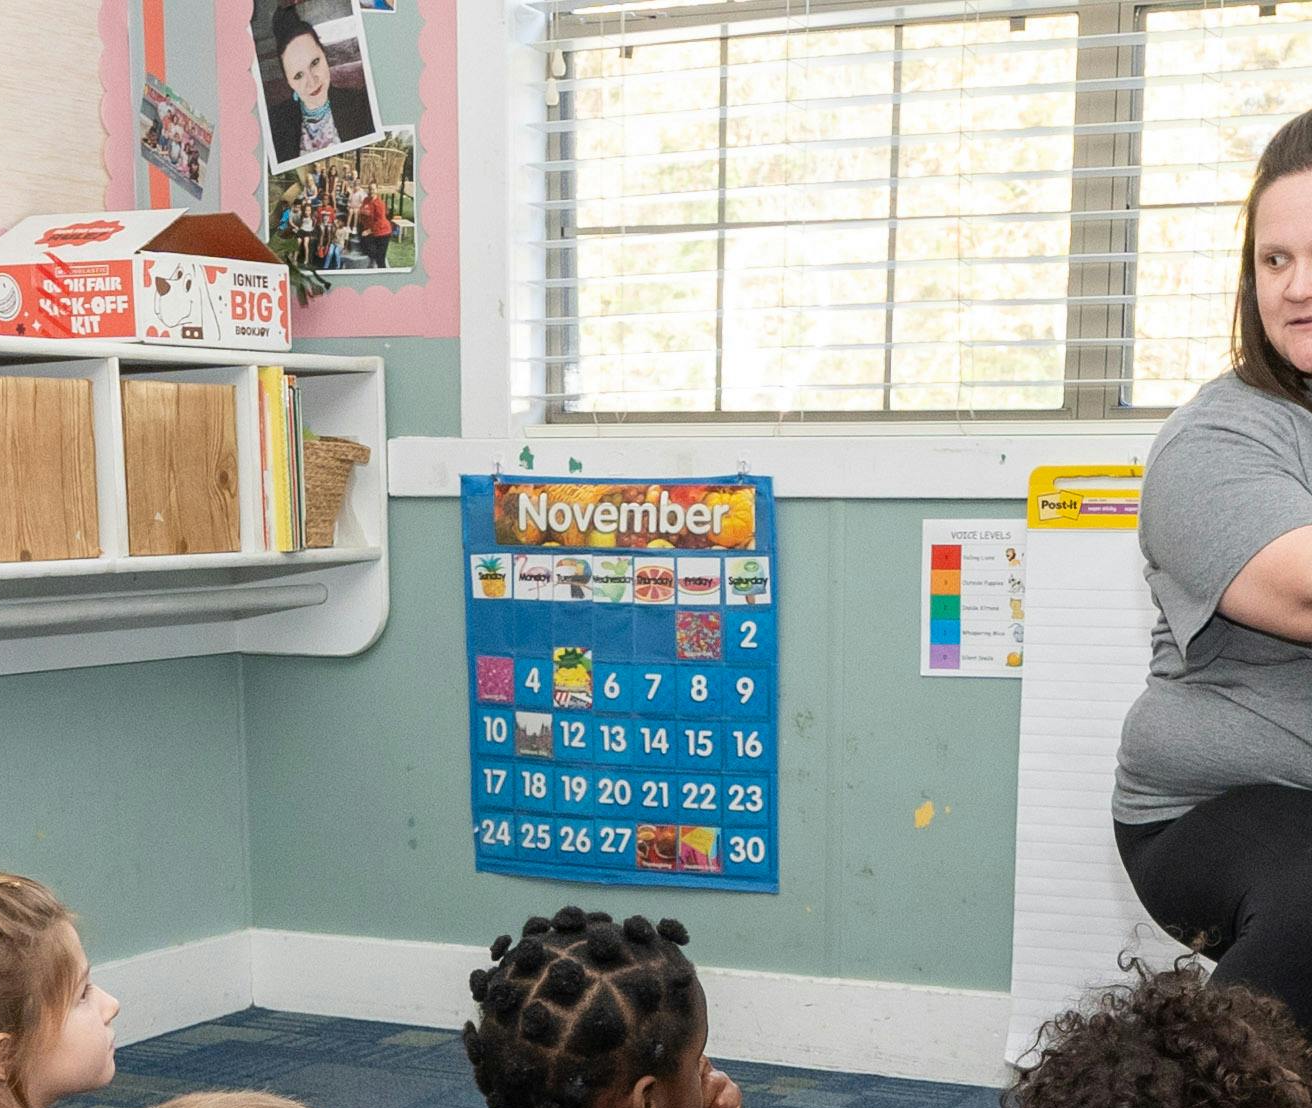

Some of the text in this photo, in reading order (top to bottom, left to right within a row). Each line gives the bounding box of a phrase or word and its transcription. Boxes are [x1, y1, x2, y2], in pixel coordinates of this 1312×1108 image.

[86, 276, 122, 291] FAIR
[233, 273, 269, 288] IGNITE
[230, 290, 273, 322] BIG
[70, 315, 101, 335] KIT
[517, 491, 729, 534] November
[1041, 500, 1078, 510] Post-it
[951, 531, 1012, 540] VOICE LEVELS
[478, 572, 507, 582] Sunday
[519, 573, 551, 583] Monday
[684, 577, 713, 587] Friday
[728, 576, 768, 589] Saturday
[740, 621, 758, 648] 2
[525, 668, 754, 704] 4 6 7 8 9
[483, 716, 763, 758] 10 12 13 14 15 16
[483, 769, 763, 812] 17 18 19 20 21 22 23
[481, 819, 765, 863] 24 25 26 27 30
